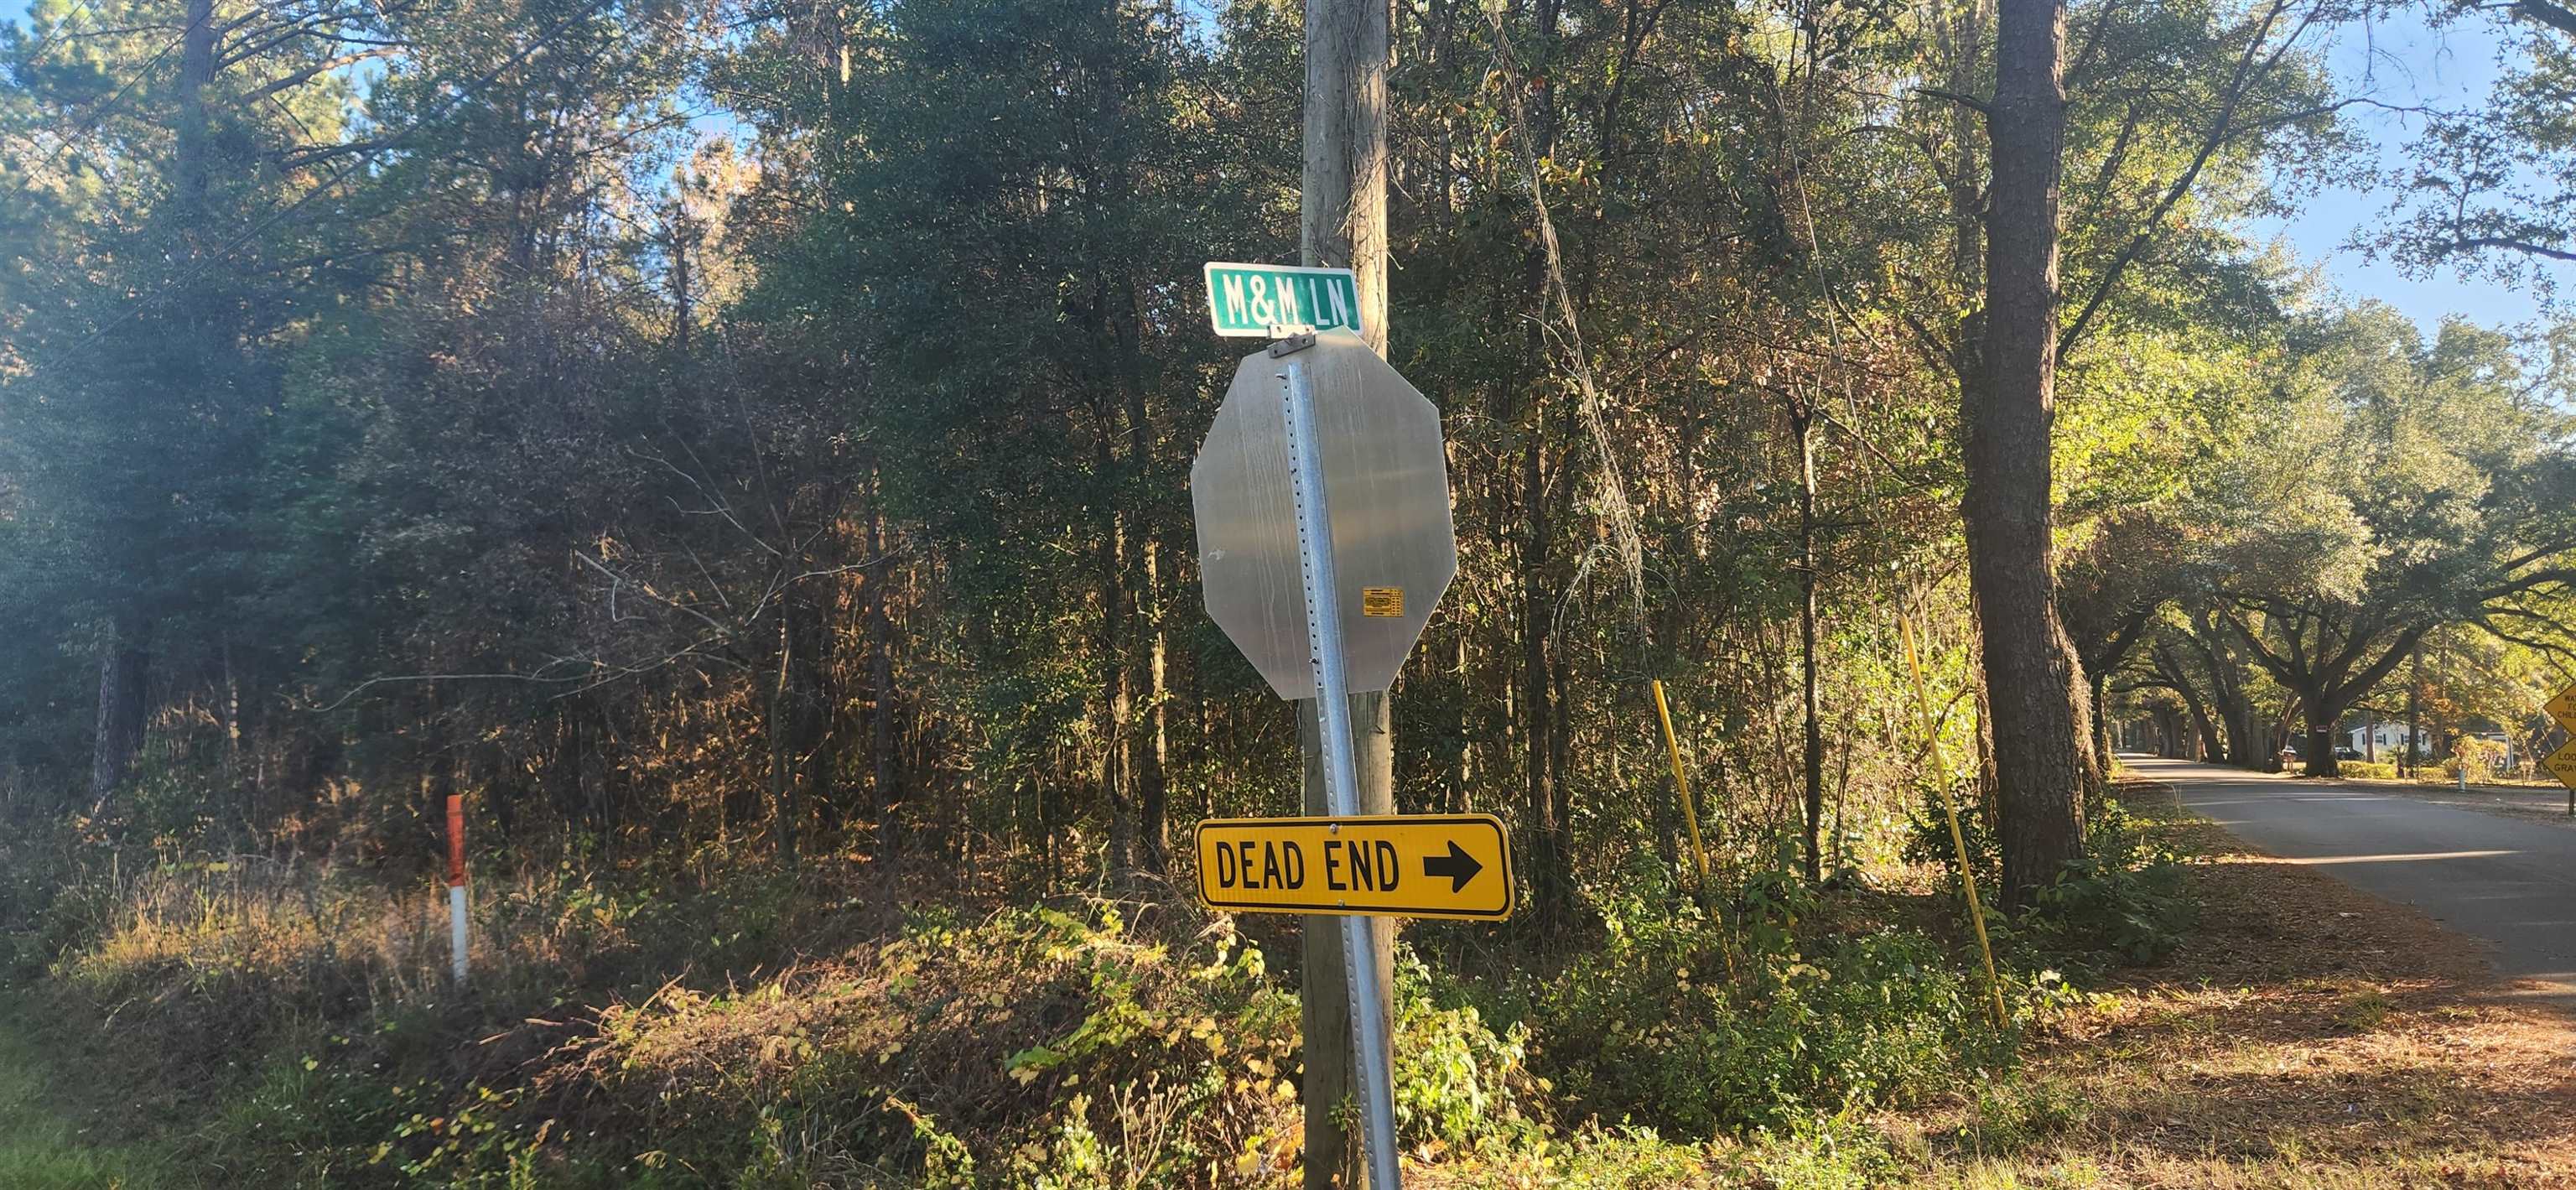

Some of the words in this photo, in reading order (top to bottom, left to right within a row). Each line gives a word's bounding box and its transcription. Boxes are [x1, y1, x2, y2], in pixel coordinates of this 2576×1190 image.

[1223, 273, 1299, 325] M&M
[1309, 278, 1348, 325] LN
[2554, 763, 2576, 772] GRA
[1216, 841, 1305, 890] DEAD
[1324, 840, 1400, 892] END
